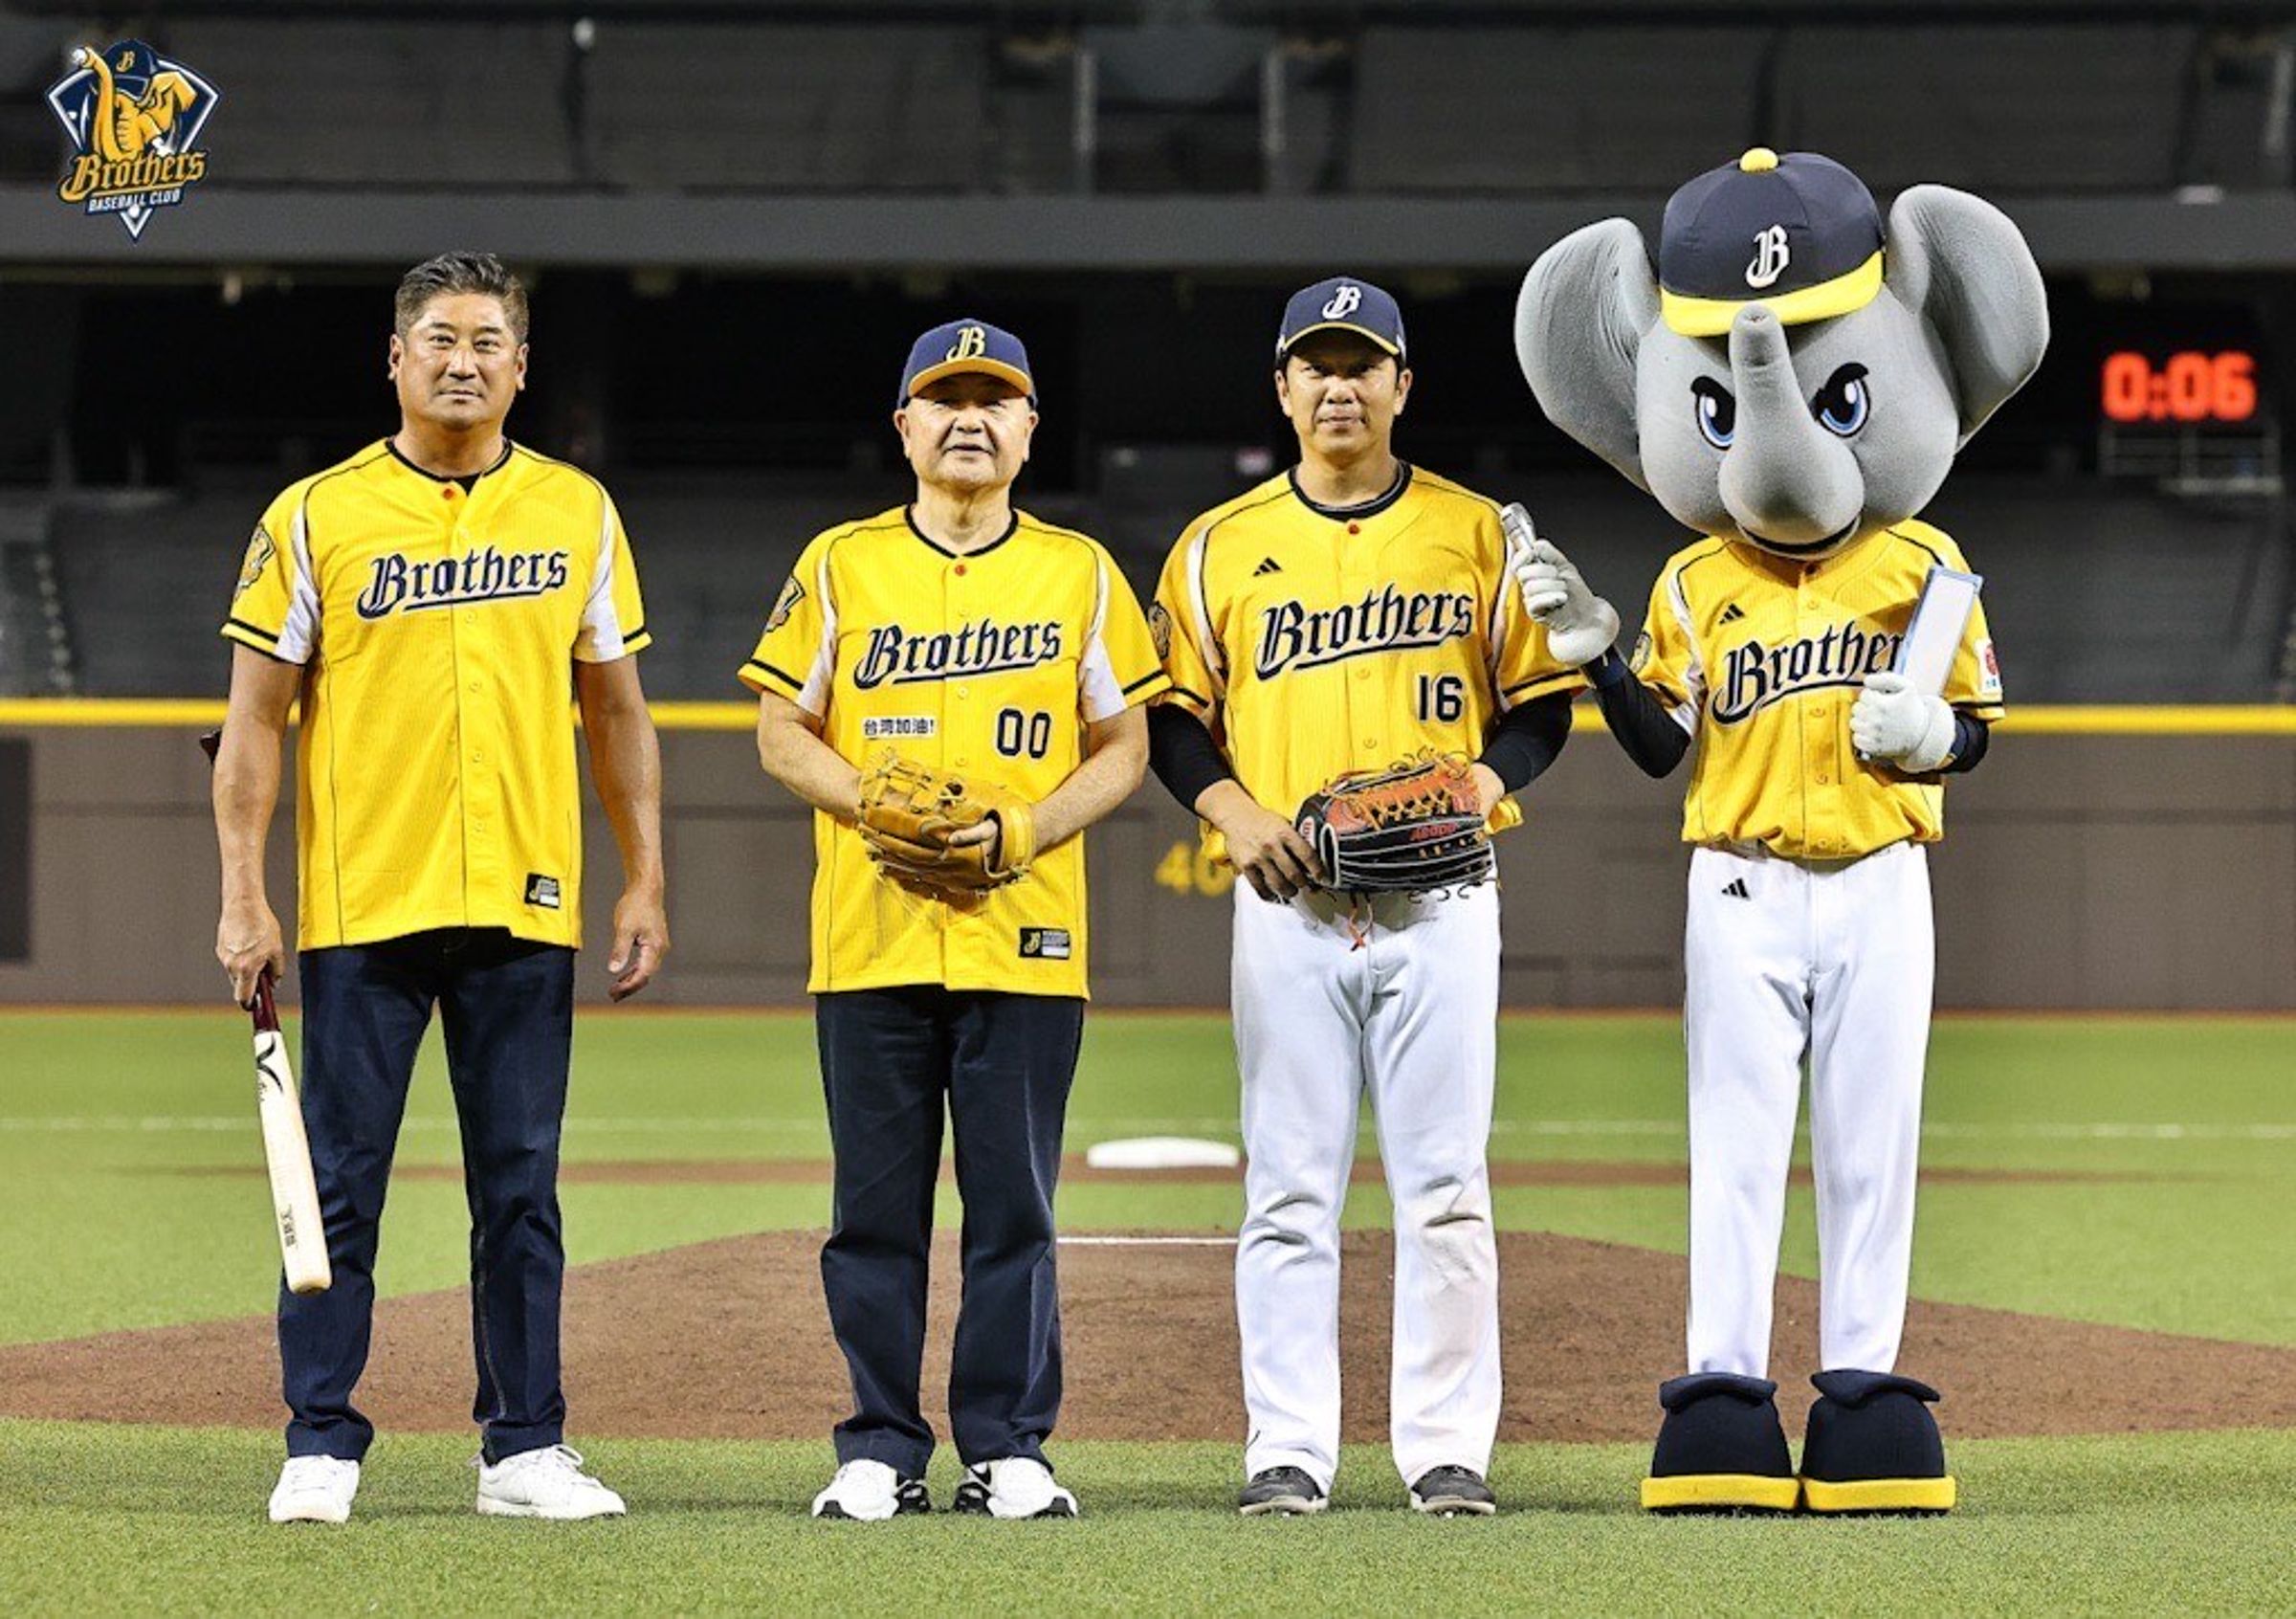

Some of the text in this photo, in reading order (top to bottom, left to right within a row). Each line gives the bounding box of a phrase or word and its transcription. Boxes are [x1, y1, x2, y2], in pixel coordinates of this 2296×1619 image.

[1745, 224, 1791, 289] B
[1322, 286, 1362, 321] B
[946, 326, 986, 363] B
[2102, 350, 2258, 422] 0:06
[356, 544, 569, 619] Brothers
[853, 617, 1064, 690] Brothers
[1255, 582, 1475, 682] Brothers
[1416, 673, 1464, 722] 16
[1711, 620, 1905, 725] Brother
[996, 708, 1051, 759] 00
